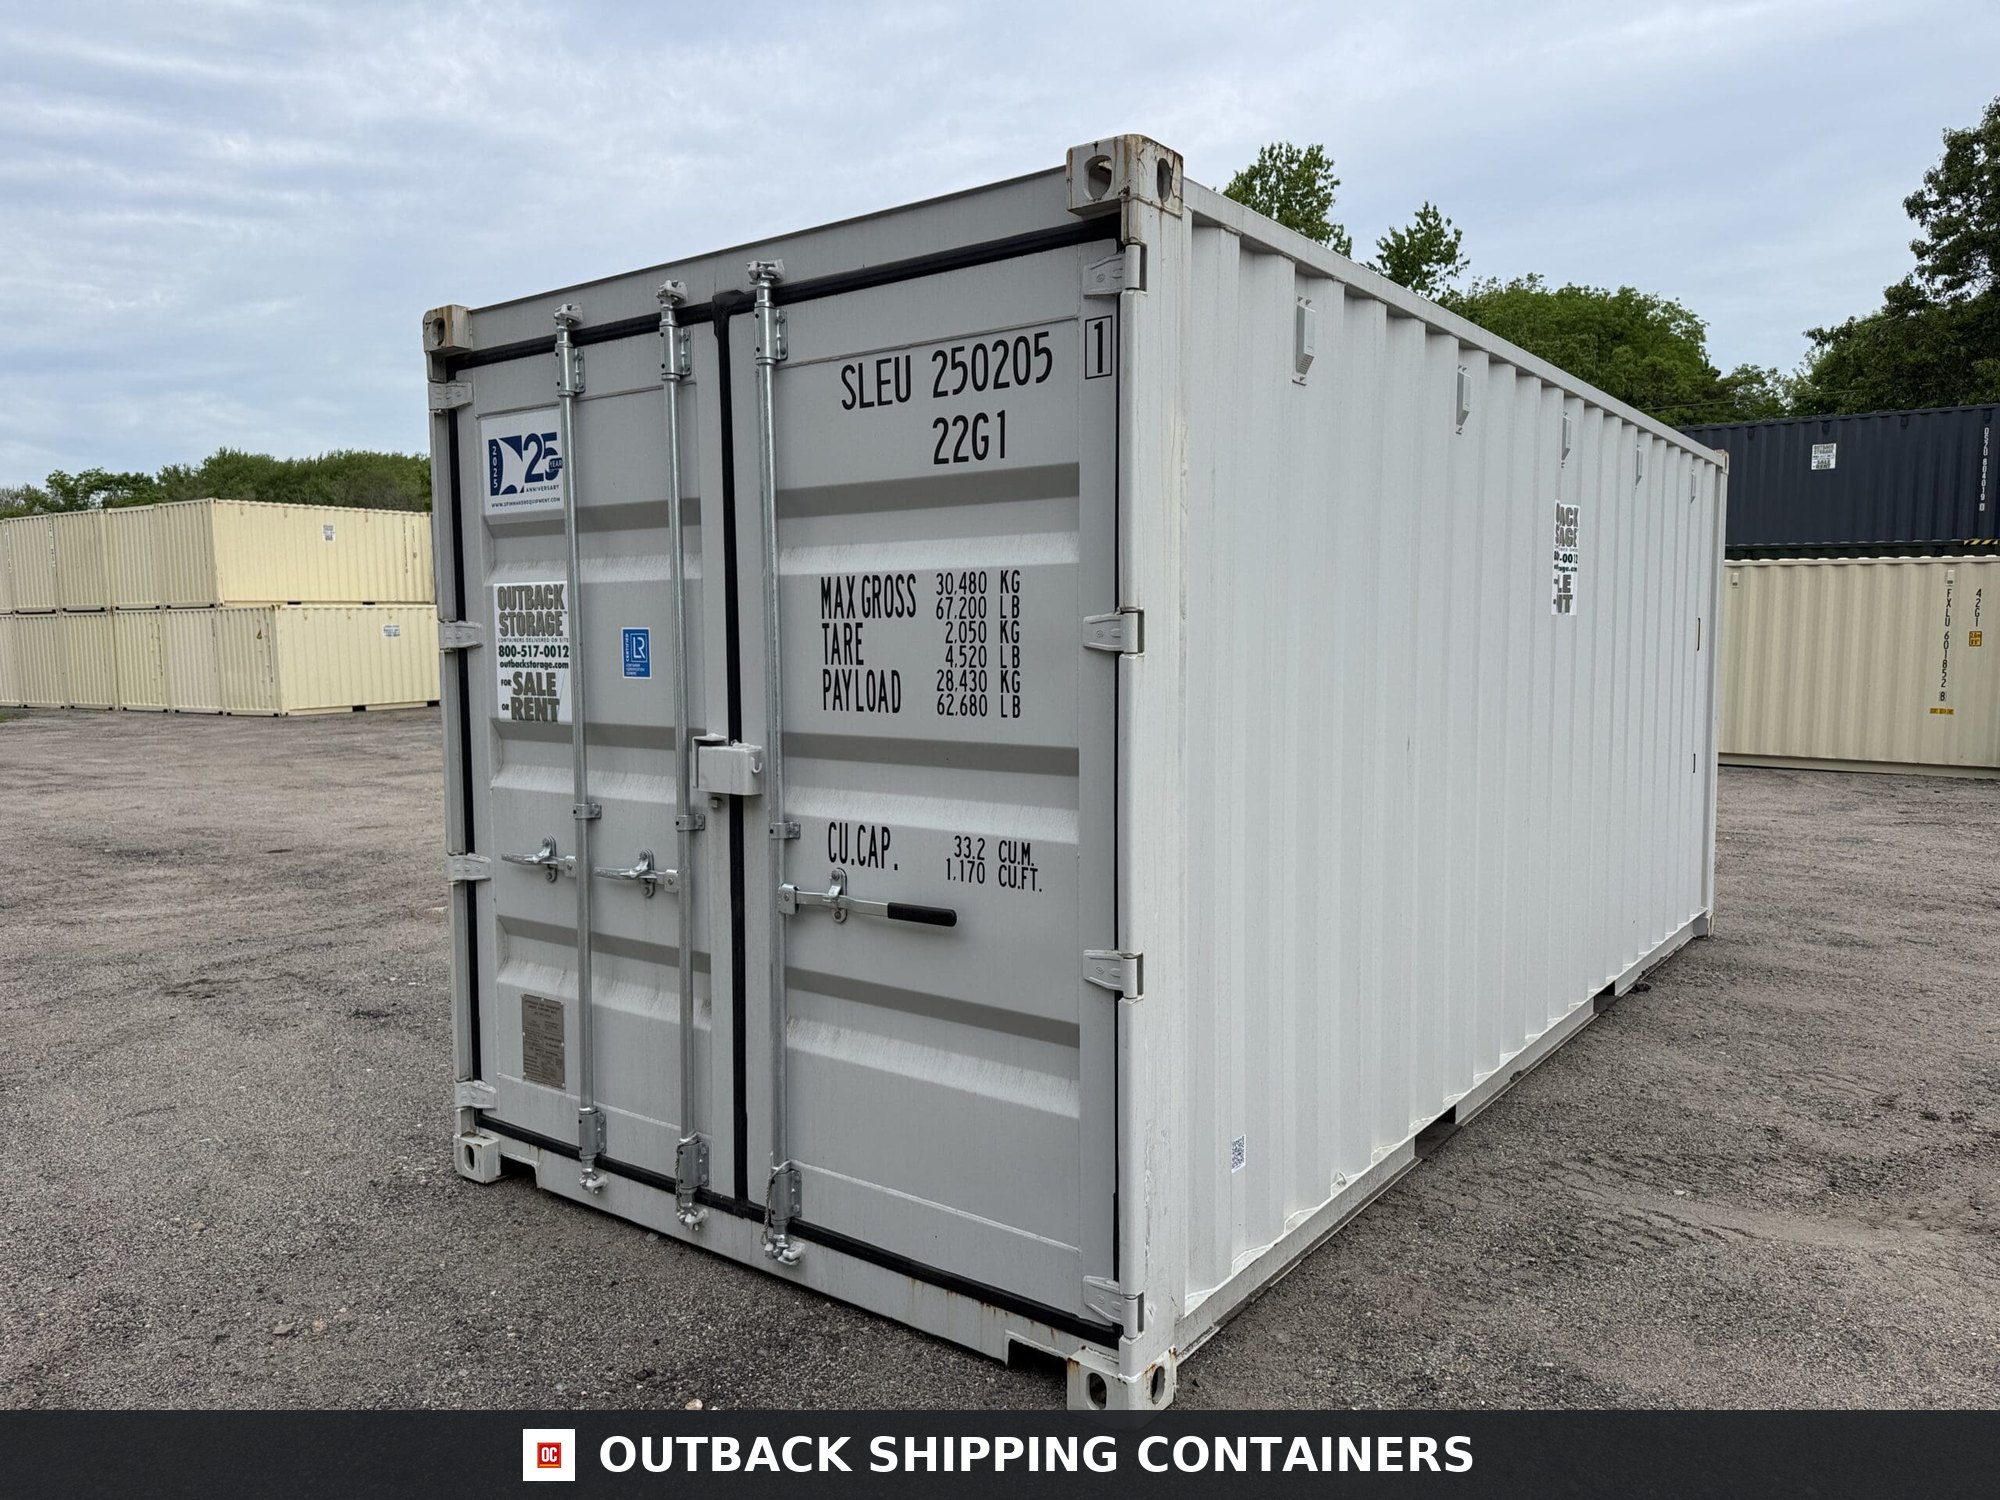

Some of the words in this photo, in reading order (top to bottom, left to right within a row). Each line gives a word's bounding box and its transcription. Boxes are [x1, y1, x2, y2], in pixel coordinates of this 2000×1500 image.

[841, 355, 911, 410] SLEU
[931, 331, 1053, 398] 250205
[1093, 321, 1104, 374] 1
[932, 409, 1006, 465] 22G1
[523, 431, 559, 483] 25
[526, 484, 560, 493] ANNIVERSARY
[497, 584, 565, 611] OUTBACK
[820, 575, 856, 620] MAX
[861, 573, 917, 619] GROSS
[1000, 569, 1021, 594] KG
[1000, 595, 1020, 619] LB
[498, 611, 564, 637] STORAGE
[498, 645, 569, 658] 800-517-0012
[821, 622, 865, 666] TARE
[1000, 620, 1021, 644] KG
[499, 659, 569, 671] outbackstorage.com
[1000, 645, 1021, 669] LB
[501, 678, 512, 687] FOR
[512, 671, 557, 697] SALE
[822, 668, 902, 714] PAYLOAD
[1000, 669, 1021, 694] KG
[510, 697, 560, 723] RENT
[1000, 694, 1021, 718] LB
[953, 835, 986, 861] 33.2
